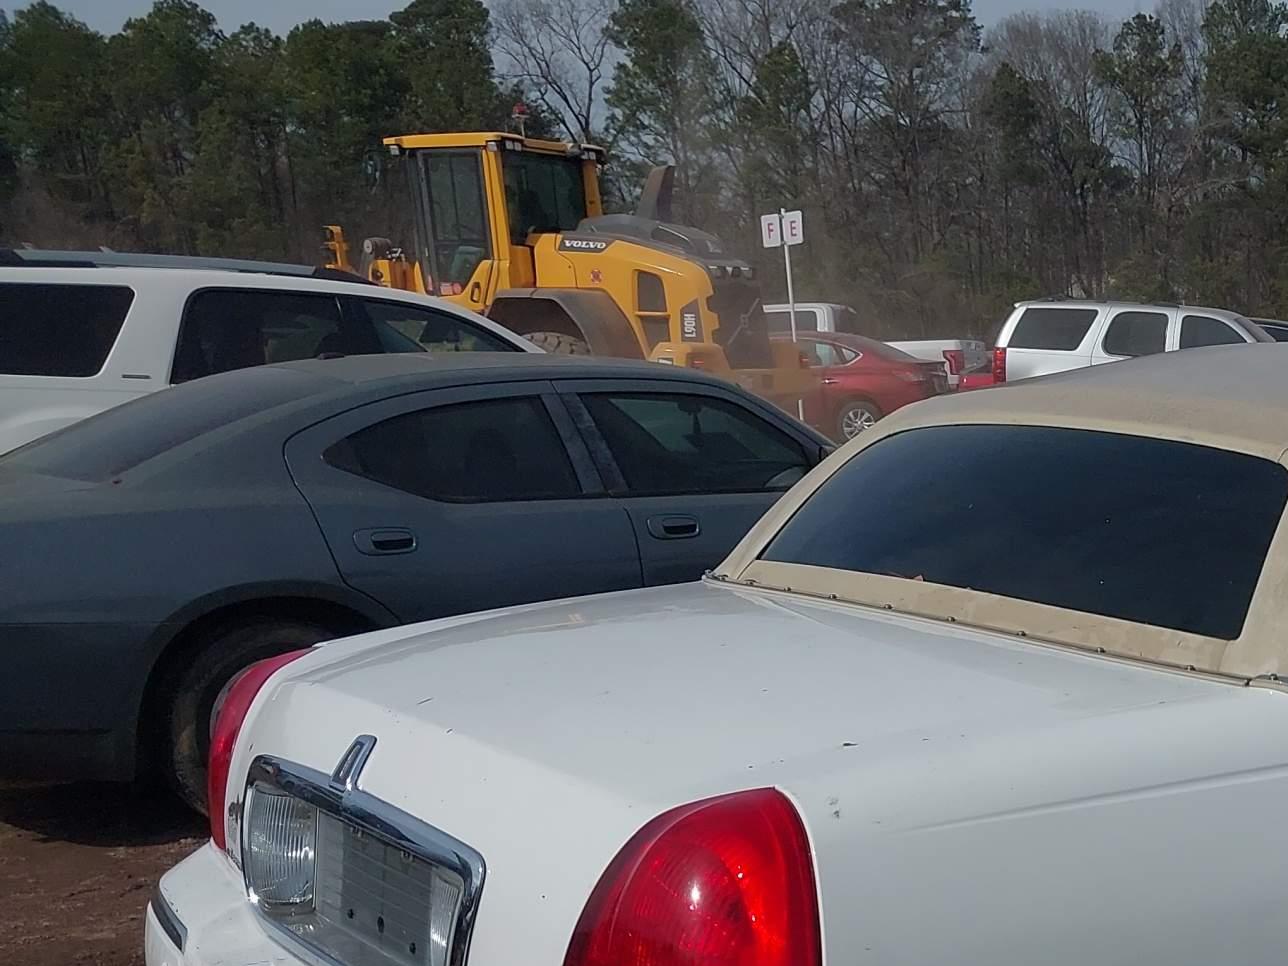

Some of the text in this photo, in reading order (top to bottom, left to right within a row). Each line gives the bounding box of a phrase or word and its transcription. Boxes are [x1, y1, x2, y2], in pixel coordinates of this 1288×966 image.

[767, 222, 774, 240] F
[789, 220, 798, 237] E
[564, 239, 607, 249] VOLVO
